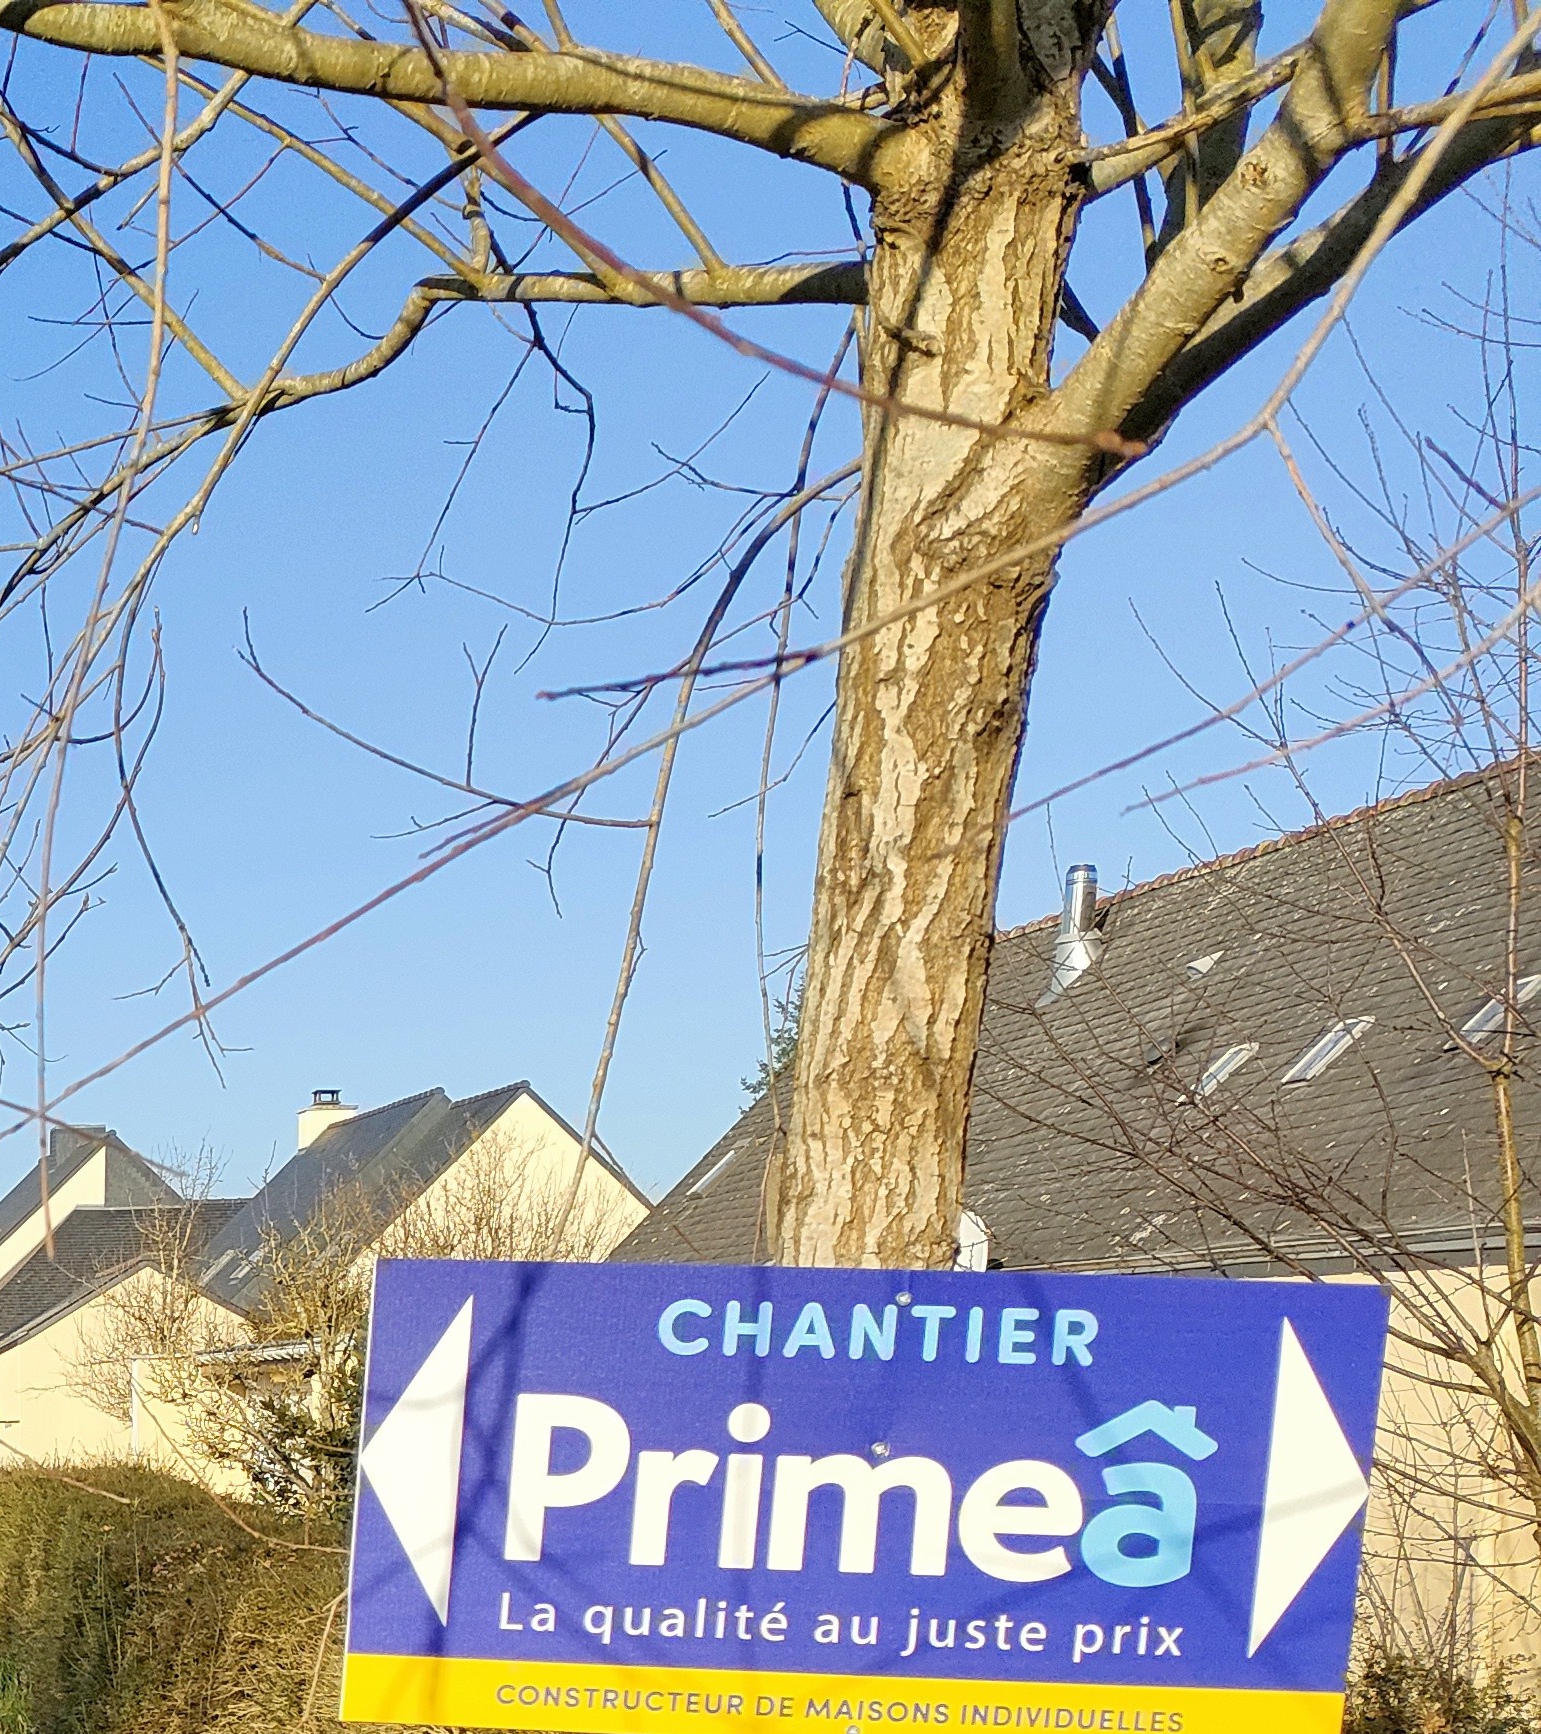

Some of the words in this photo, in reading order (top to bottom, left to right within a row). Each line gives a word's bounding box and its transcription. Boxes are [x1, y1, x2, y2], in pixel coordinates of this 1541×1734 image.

[657, 1298, 1099, 1367] CHANTIER
[498, 1591, 556, 1632] La
[582, 1596, 788, 1645] qualité
[813, 1613, 879, 1645] au
[899, 1606, 1047, 1657] juste
[1071, 1614, 1184, 1663] prix
[496, 1684, 743, 1716] CONSTRUCTEUR
[755, 1694, 795, 1718] DE
[805, 1698, 949, 1725] MAISONS
[961, 1704, 1184, 1733] INDIVIDUELLES
